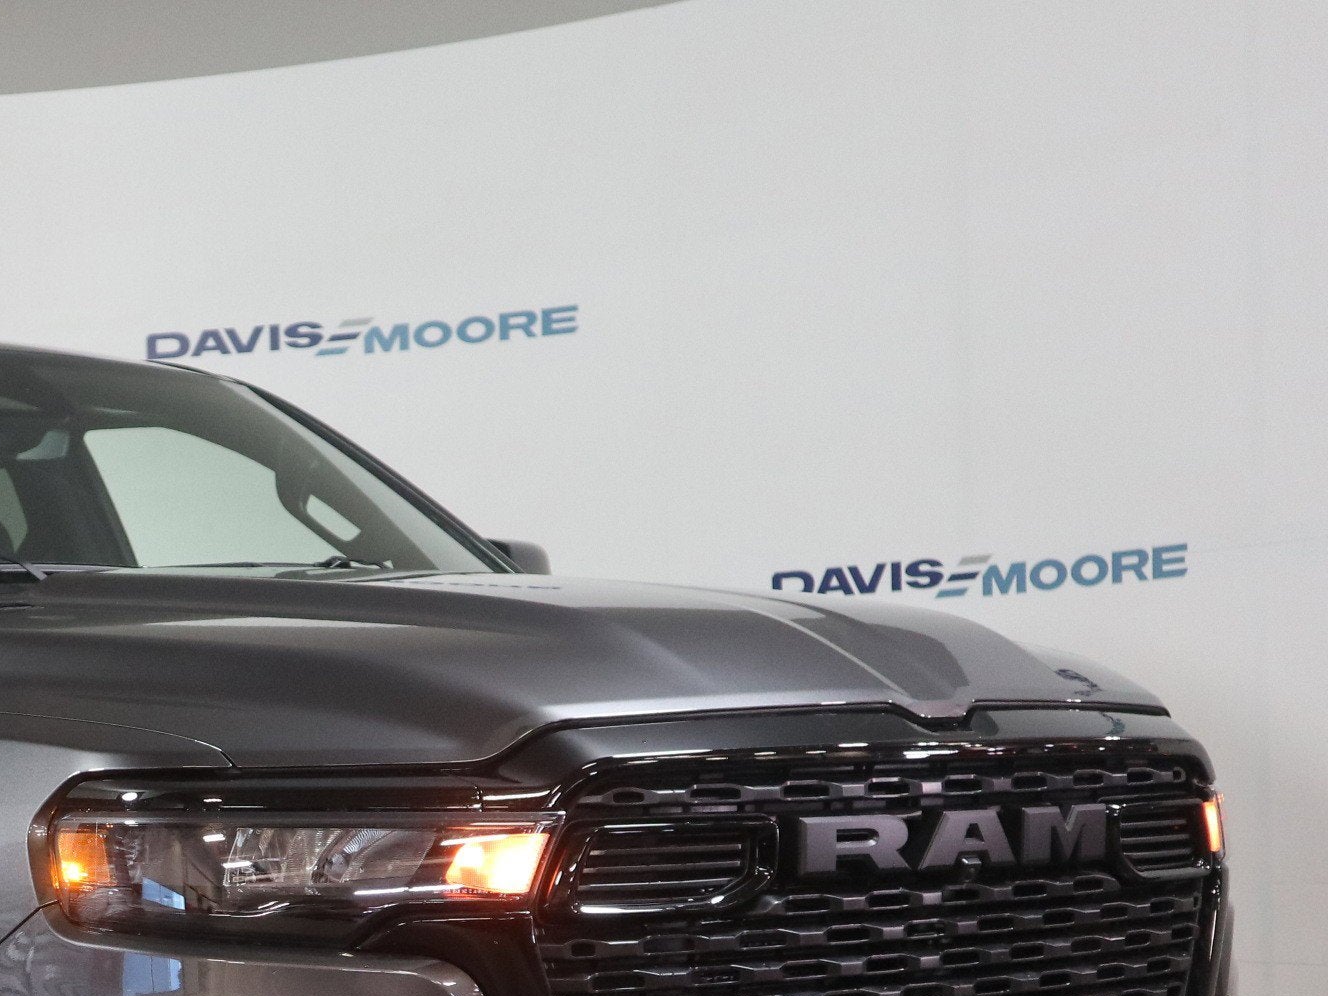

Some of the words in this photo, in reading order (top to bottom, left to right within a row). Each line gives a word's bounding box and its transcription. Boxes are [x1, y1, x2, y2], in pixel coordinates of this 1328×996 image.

[146, 320, 325, 360] DAVIS
[363, 304, 580, 354] MOORE
[772, 558, 945, 596] DAVIS
[981, 543, 1189, 597] MOORE
[799, 803, 1107, 875] RAM
